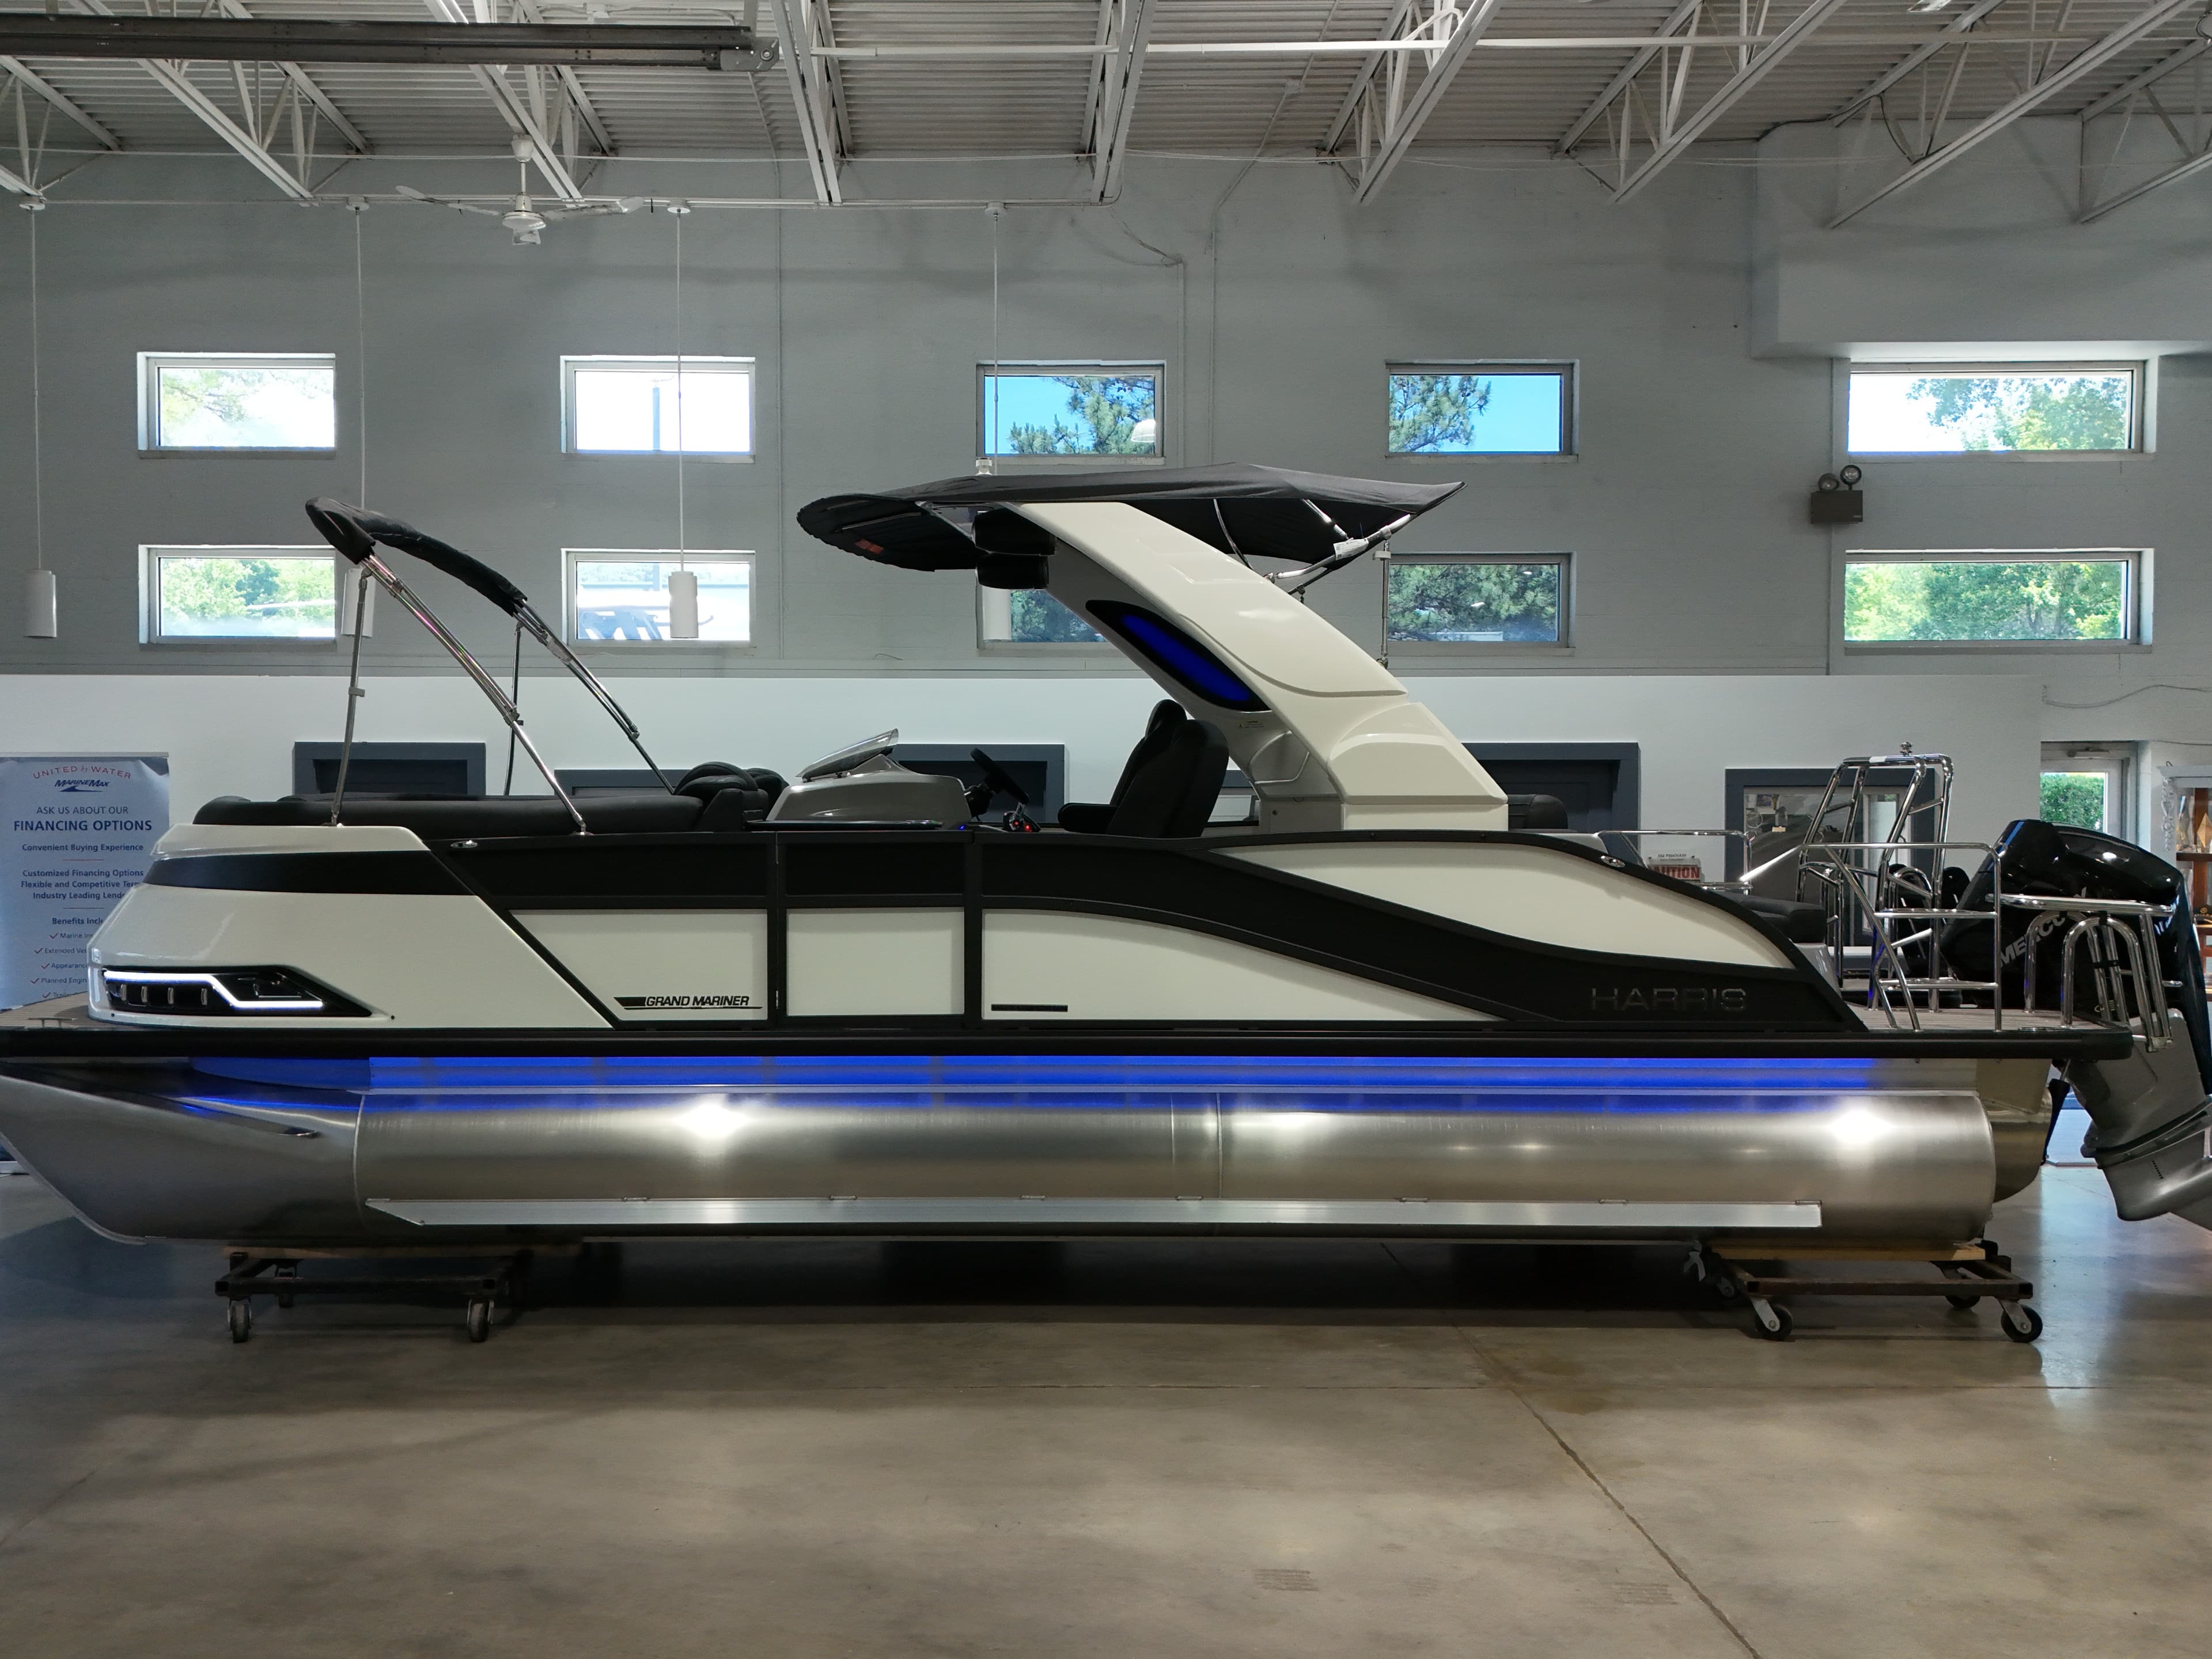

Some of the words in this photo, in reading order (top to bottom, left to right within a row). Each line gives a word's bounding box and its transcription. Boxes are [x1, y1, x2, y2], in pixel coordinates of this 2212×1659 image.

[33, 766, 78, 779] UNITED
[90, 766, 131, 779] WATER
[36, 806, 55, 815] ASK
[58, 806, 70, 815] US
[73, 806, 106, 815] ABOUT
[108, 806, 128, 815] OUR
[14, 820, 88, 831] FINANCING
[93, 820, 152, 831] OPTIONS
[71, 844, 98, 853] Buying
[101, 844, 143, 853] Experience
[22, 869, 70, 877] Customized
[72, 869, 110, 878] Financing
[112, 869, 143, 878] Options
[72, 881, 120, 890] Competitive
[33, 892, 67, 900] Industry
[69, 892, 100, 900] Leading
[646, 995, 690, 1006] GRAND
[692, 995, 750, 1006] MARINER
[1591, 987, 1746, 1010] HARRIS
